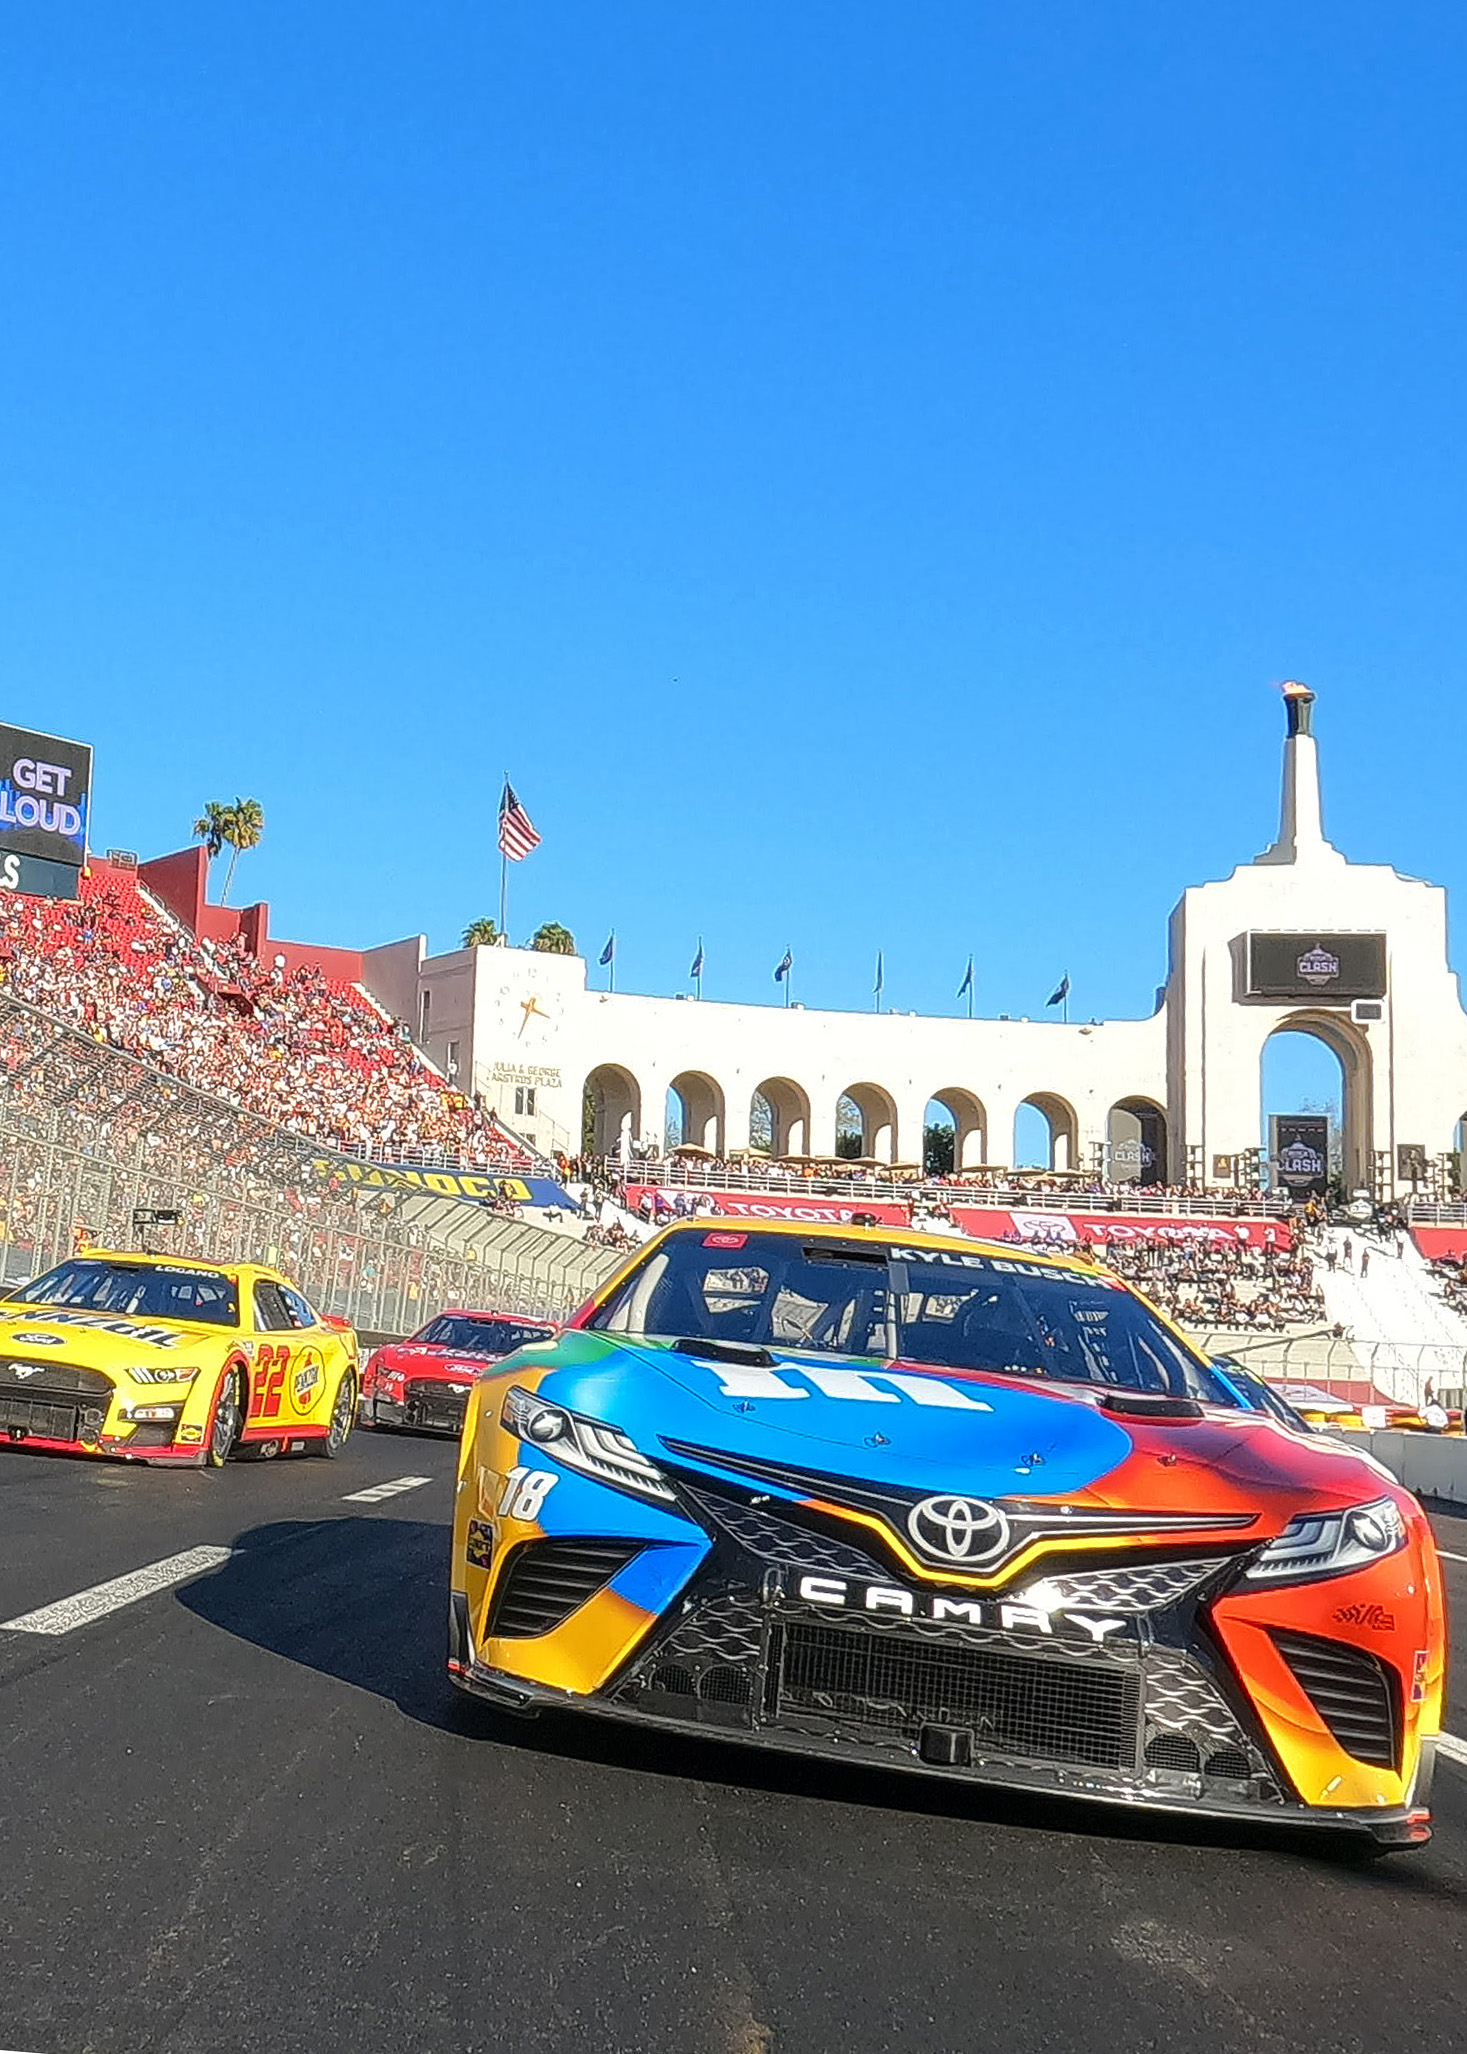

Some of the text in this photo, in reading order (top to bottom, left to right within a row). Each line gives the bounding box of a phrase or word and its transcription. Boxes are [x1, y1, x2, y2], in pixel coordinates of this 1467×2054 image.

[13, 758, 72, 797] GET
[0, 790, 81, 836] LOUD
[1299, 961, 1338, 974] CLASH
[1114, 1151, 1150, 1163] CLASH
[1276, 1158, 1322, 1173] CLASH
[728, 1202, 858, 1222] TOYOTA
[155, 1265, 220, 1279] LOGANO
[890, 1248, 1114, 1291] KYLE BUSCH
[250, 1343, 291, 1418] 22
[498, 1466, 560, 1521] 18
[799, 1575, 1128, 1643] CAMRY
